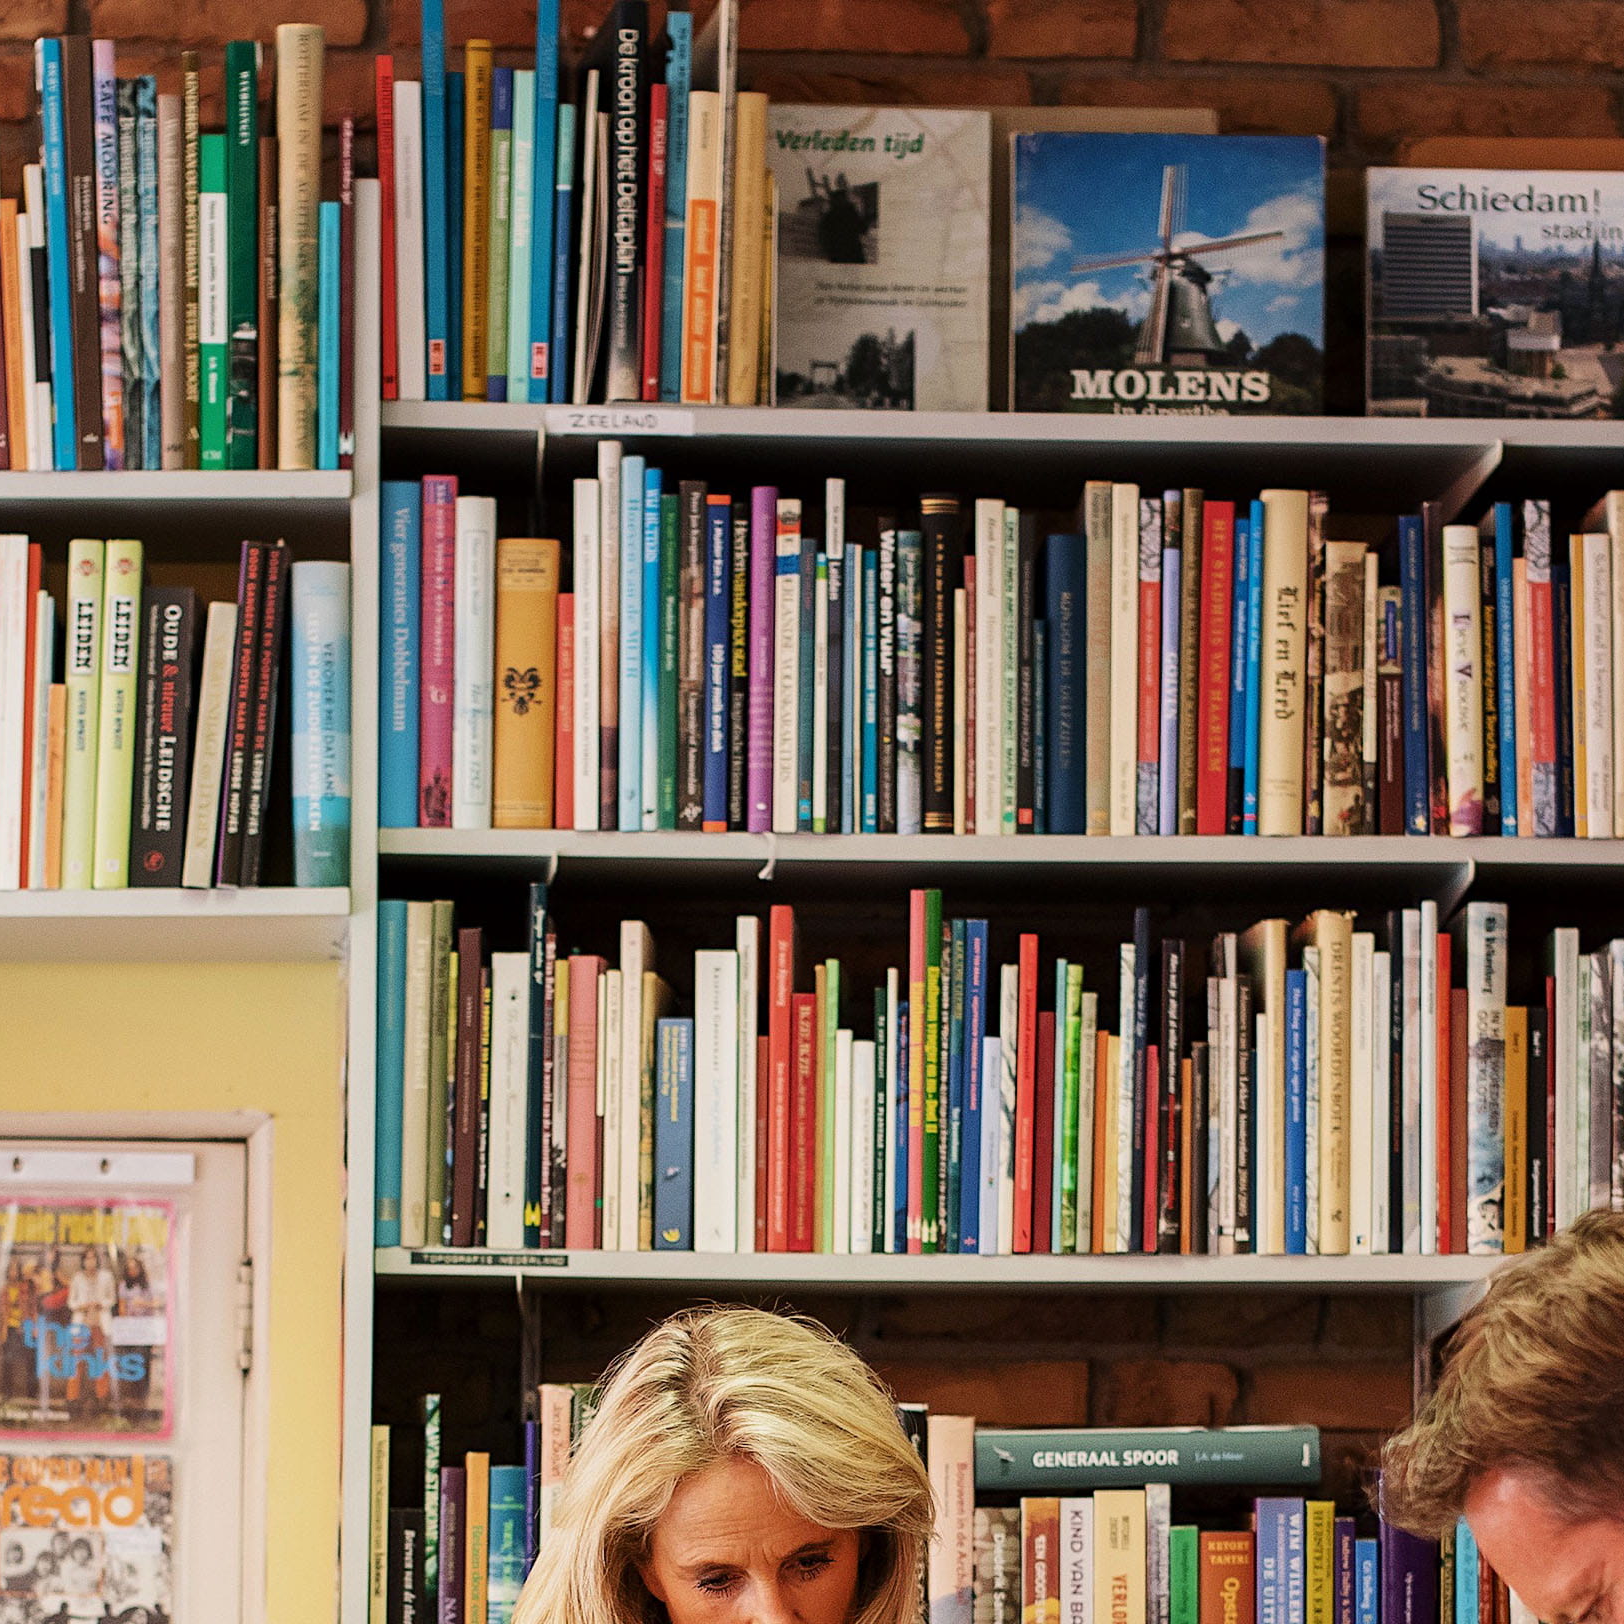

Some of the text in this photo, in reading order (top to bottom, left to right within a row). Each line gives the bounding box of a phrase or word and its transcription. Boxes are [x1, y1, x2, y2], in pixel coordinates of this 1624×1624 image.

[297, 33, 312, 122] ROTTERDAM
[99, 79, 115, 225] SAFE MOORING
[615, 29, 639, 273] De kroon op het Deltaplan
[776, 129, 925, 159] Verleden tijd
[1417, 184, 1601, 214] Schiedam!
[1542, 222, 1592, 241] stad
[1595, 222, 1622, 242] in
[1070, 369, 1271, 402] MOLENS
[569, 413, 659, 431] ZEELAND
[828, 561, 841, 601] Leiden
[389, 507, 410, 732] Vier generaties Dobbelmann
[879, 530, 895, 675] Water en vuur
[75, 601, 94, 668] LEIDEN
[113, 600, 132, 668] LEIDEN
[1207, 518, 1225, 772] HET STADHUIS VAN HAARLEM
[307, 646, 320, 665] EN
[307, 668, 320, 687] DE
[155, 604, 182, 832] OUDE & nieuwe LEIDSCHE
[322, 643, 335, 802] VEROVER DAT LAND
[227, 751, 243, 833] LEIDSE HOFJES
[247, 753, 263, 836] LEIDSE HOFJES
[1330, 941, 1342, 1135] DRENTS WOORDENBOEK
[22, 1316, 92, 1350] the
[36, 1349, 147, 1382] kinks
[1032, 1448, 1180, 1469] GENERAAL SPOOR
[1070, 1510, 1083, 1552] KIND
[1288, 1513, 1300, 1551] WIM
[1070, 1559, 1083, 1596] VAN
[1263, 1557, 1273, 1580] DE
